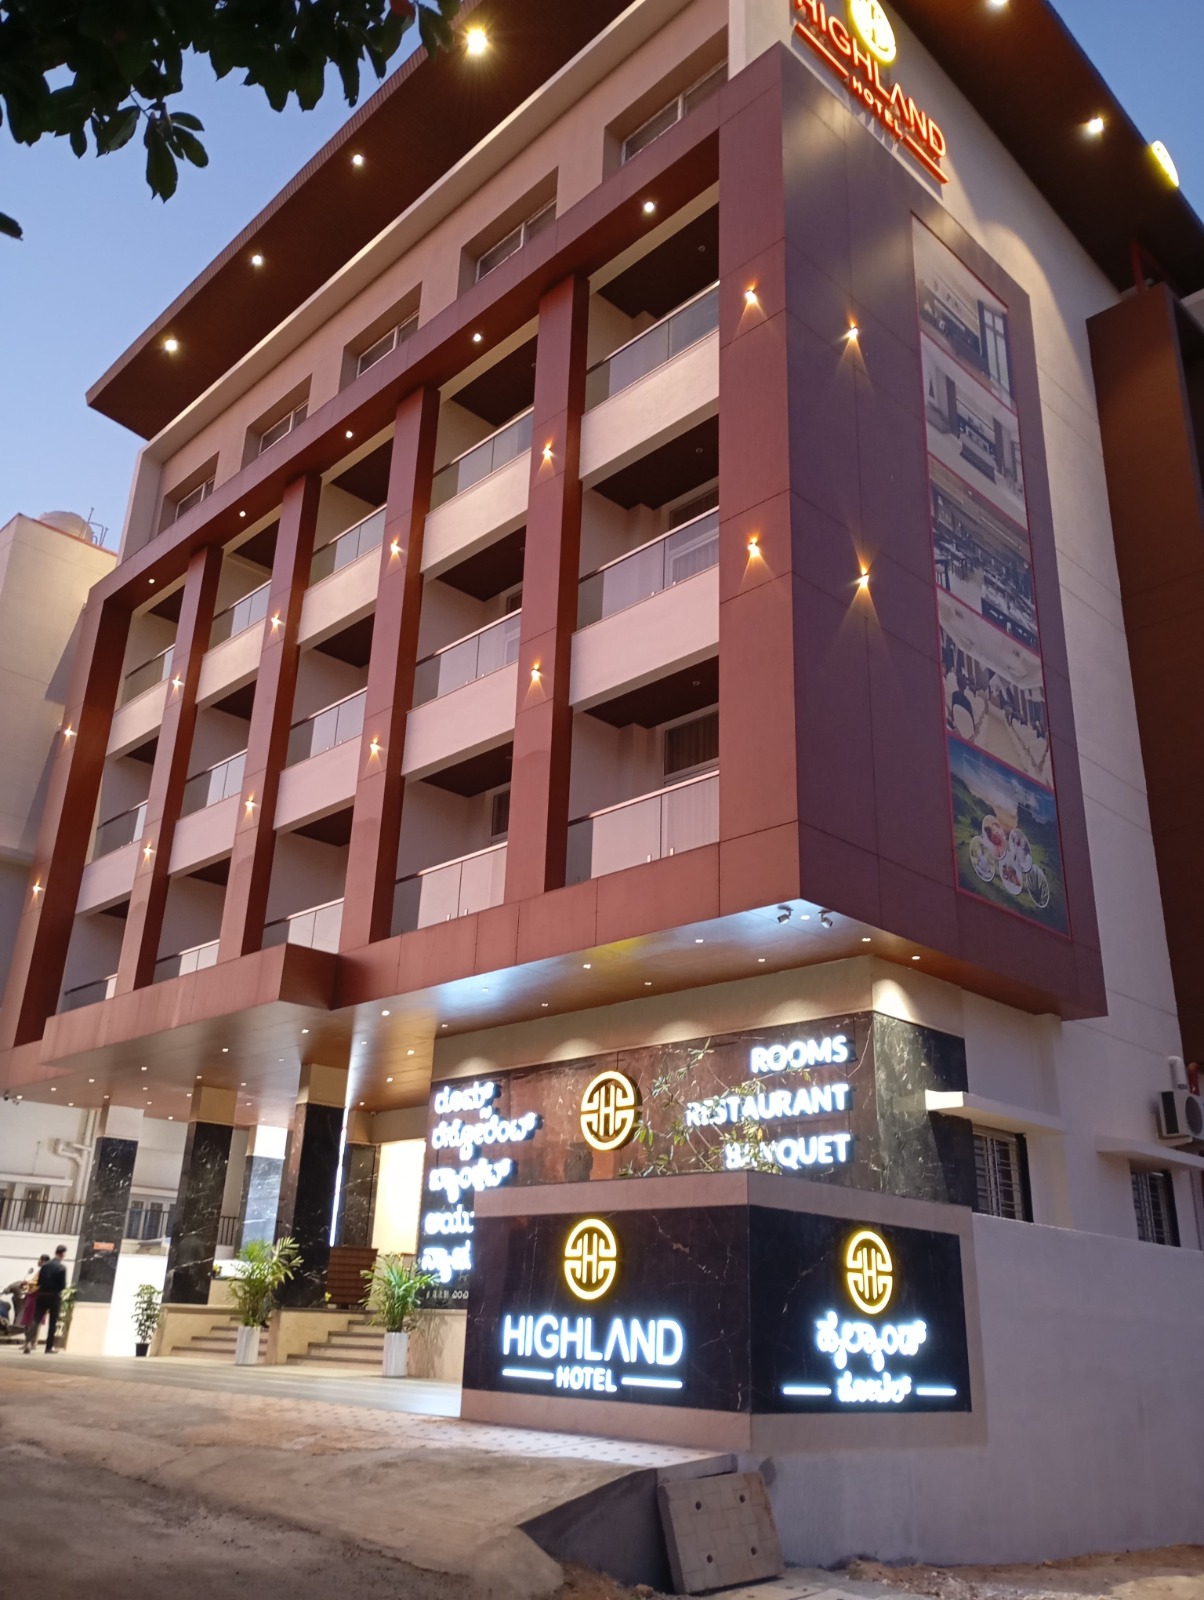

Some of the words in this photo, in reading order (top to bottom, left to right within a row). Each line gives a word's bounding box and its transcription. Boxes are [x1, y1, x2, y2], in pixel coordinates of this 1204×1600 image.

[852, 75, 903, 137] HOTEL
[751, 1034, 849, 1074] ROOMS
[503, 1314, 684, 1366] HIGHLAND
[556, 1365, 618, 1393] HOTEL
